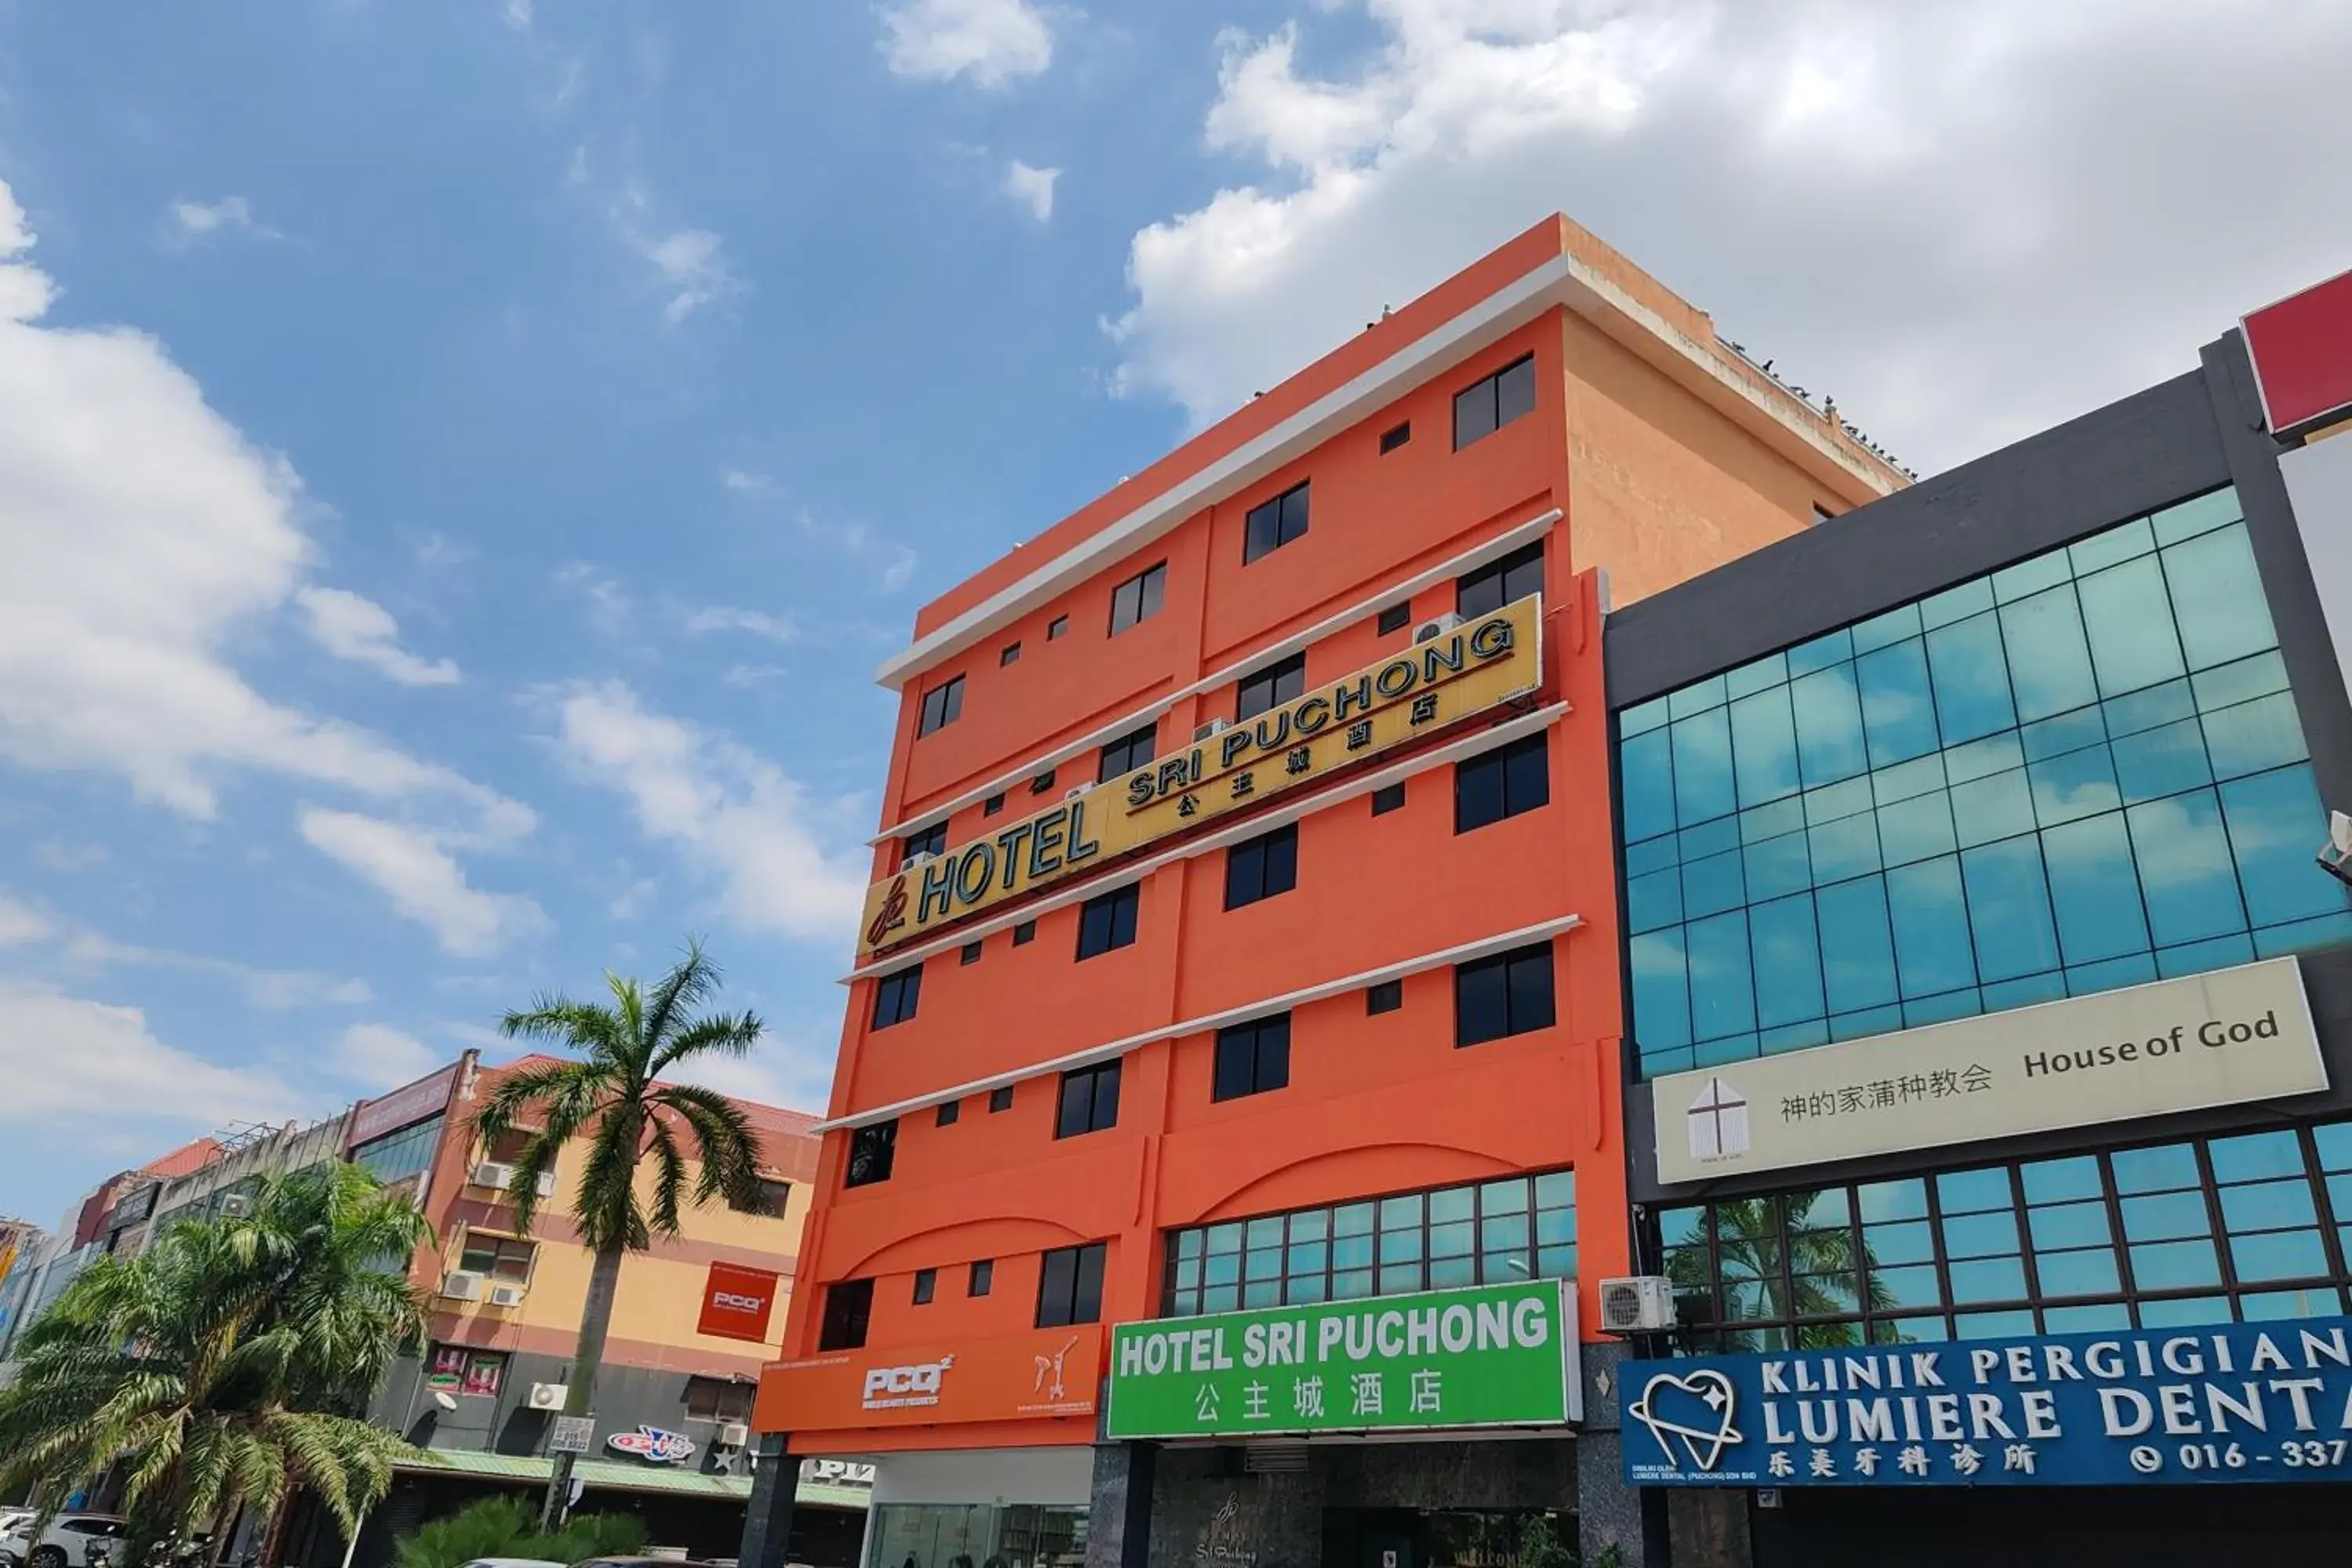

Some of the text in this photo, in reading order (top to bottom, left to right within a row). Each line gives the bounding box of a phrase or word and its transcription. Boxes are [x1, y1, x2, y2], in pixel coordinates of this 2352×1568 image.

[917, 618, 1515, 923] HOTEL SRI PUCHONG
[1177, 692, 1438, 818] 公主城酒店
[2024, 1010, 2279, 1078] House of God
[1780, 1063, 1993, 1123] 神的家蒲种教会
[1120, 1297, 1548, 1377] HOTEL SRI PUCHONG
[1761, 1327, 2350, 1394] KLINIK PERGIGIAN
[1195, 1367, 1443, 1421] 公主城酒店
[1762, 1377, 2352, 1445] LUMIERE DENT
[1768, 1443, 2038, 1478] 乐美牙科诊所
